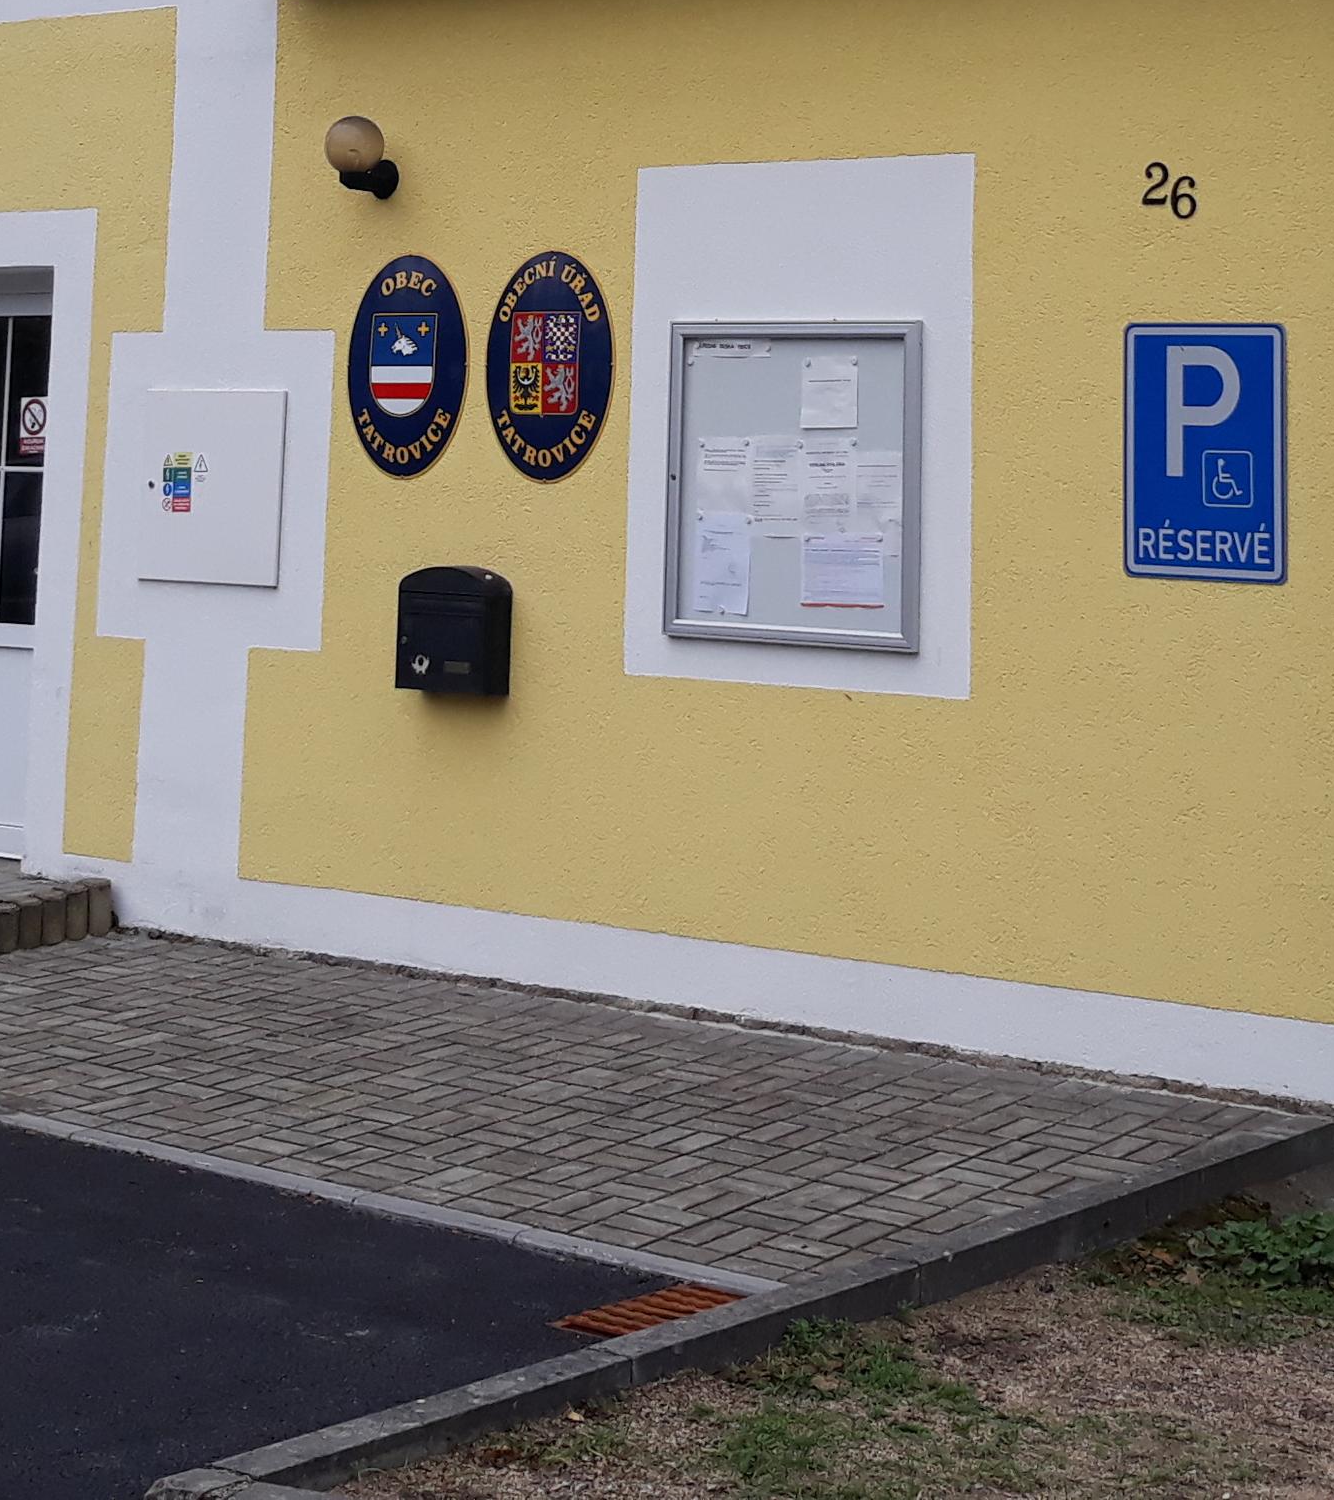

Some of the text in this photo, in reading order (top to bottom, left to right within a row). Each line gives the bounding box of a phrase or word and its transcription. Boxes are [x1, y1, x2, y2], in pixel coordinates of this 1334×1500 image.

[1142, 161, 1197, 219] 26
[380, 271, 437, 297] OBEC
[498, 256, 601, 323] OBECNÍ ÚŘAD
[357, 408, 451, 464] TATROVICE
[497, 410, 597, 467] TATROVICE
[1165, 345, 1241, 477] P
[1138, 519, 1271, 565] RÉSERVÉ
